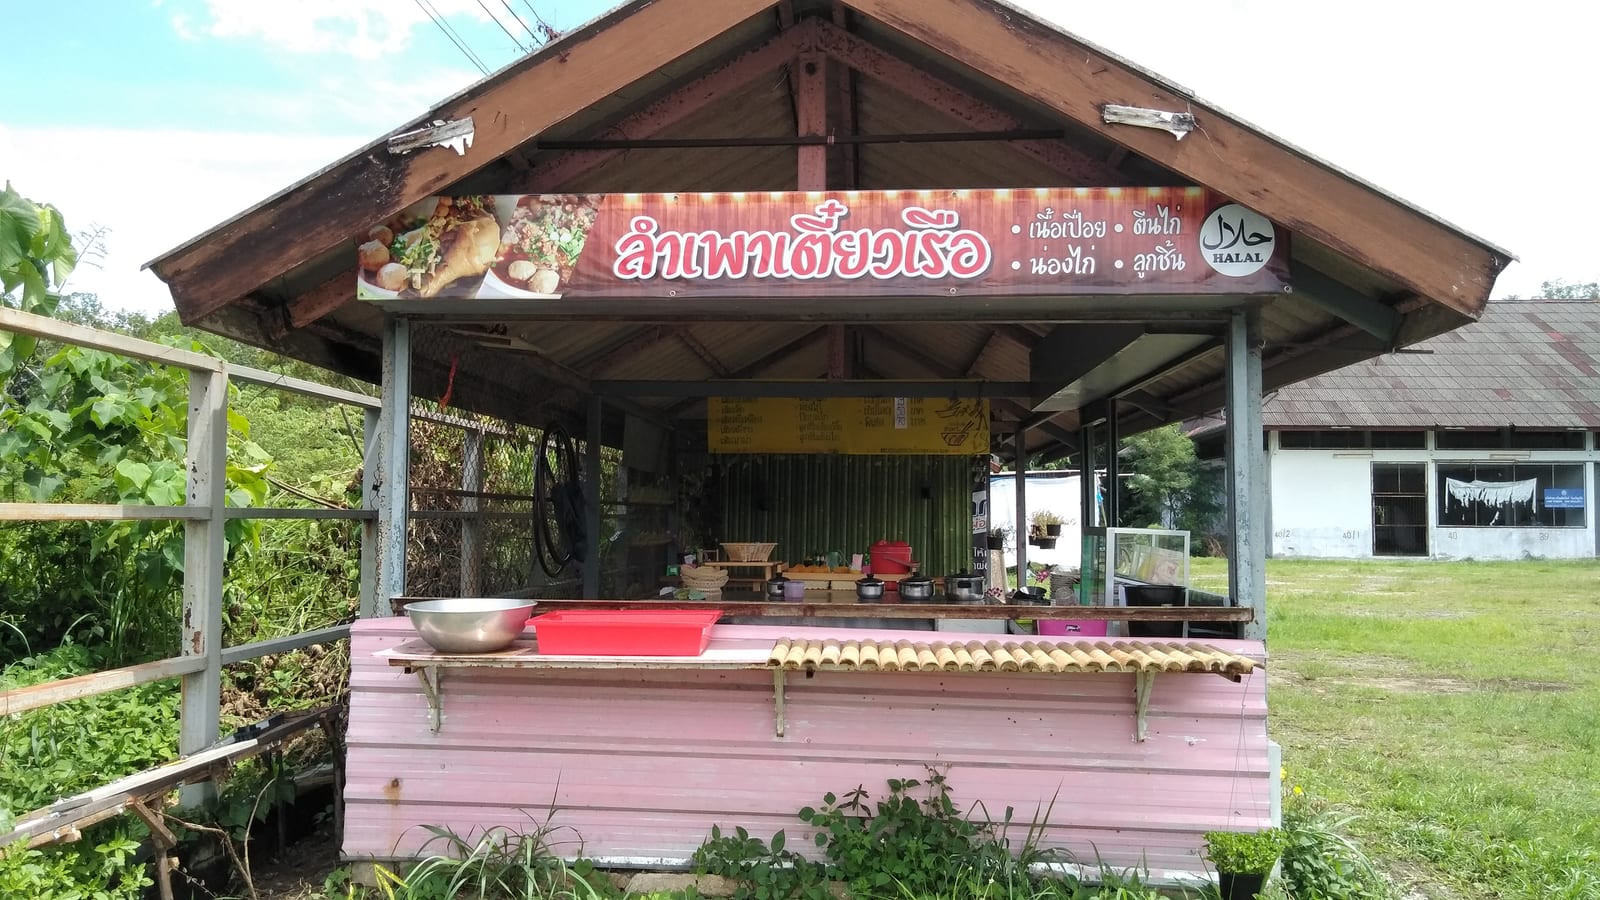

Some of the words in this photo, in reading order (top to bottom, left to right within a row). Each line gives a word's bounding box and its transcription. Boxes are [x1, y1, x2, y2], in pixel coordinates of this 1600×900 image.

[1029, 208, 1106, 239] เนื้อเปื่อย
[1134, 204, 1182, 236] ตีนไก่
[1202, 214, 1273, 250] حلال
[613, 199, 993, 280] ลำเพาเตี๋ยวเรือ
[1030, 244, 1096, 275] น่องไก่
[1133, 240, 1186, 279] ลูกชิ้น
[1212, 253, 1264, 264] HALAL
